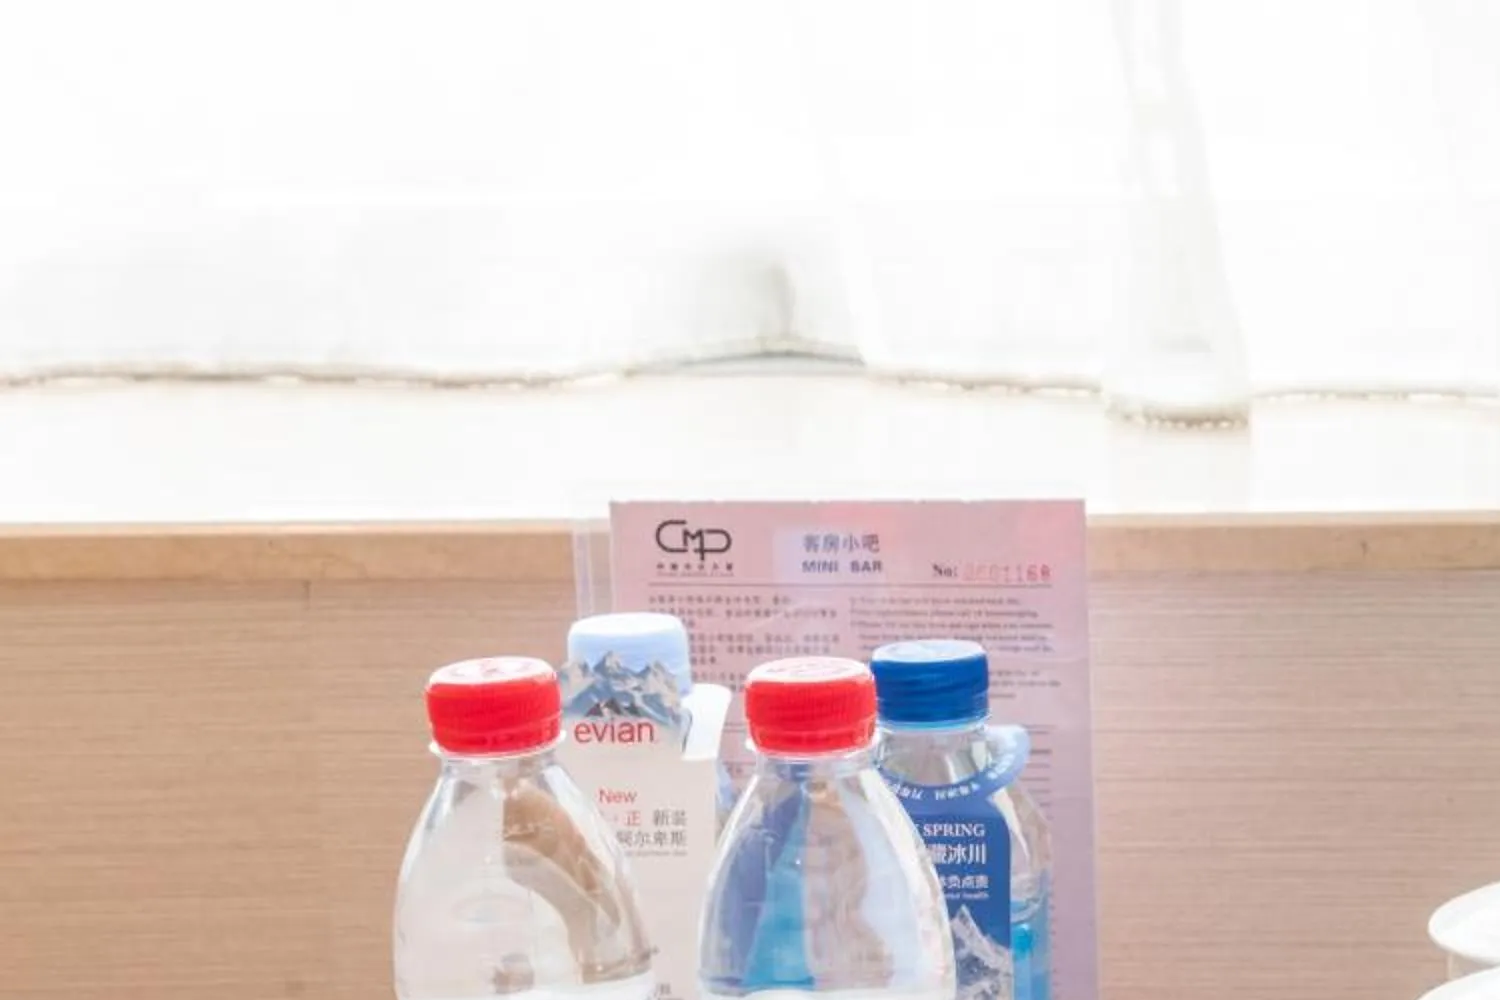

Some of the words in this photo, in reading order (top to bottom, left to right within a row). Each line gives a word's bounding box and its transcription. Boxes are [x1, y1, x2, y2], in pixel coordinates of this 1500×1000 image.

[802, 560, 839, 574] MINI
[850, 560, 883, 573] BAR
[574, 718, 655, 744] evian
[599, 788, 637, 804] New
[923, 822, 986, 837] SPRING
